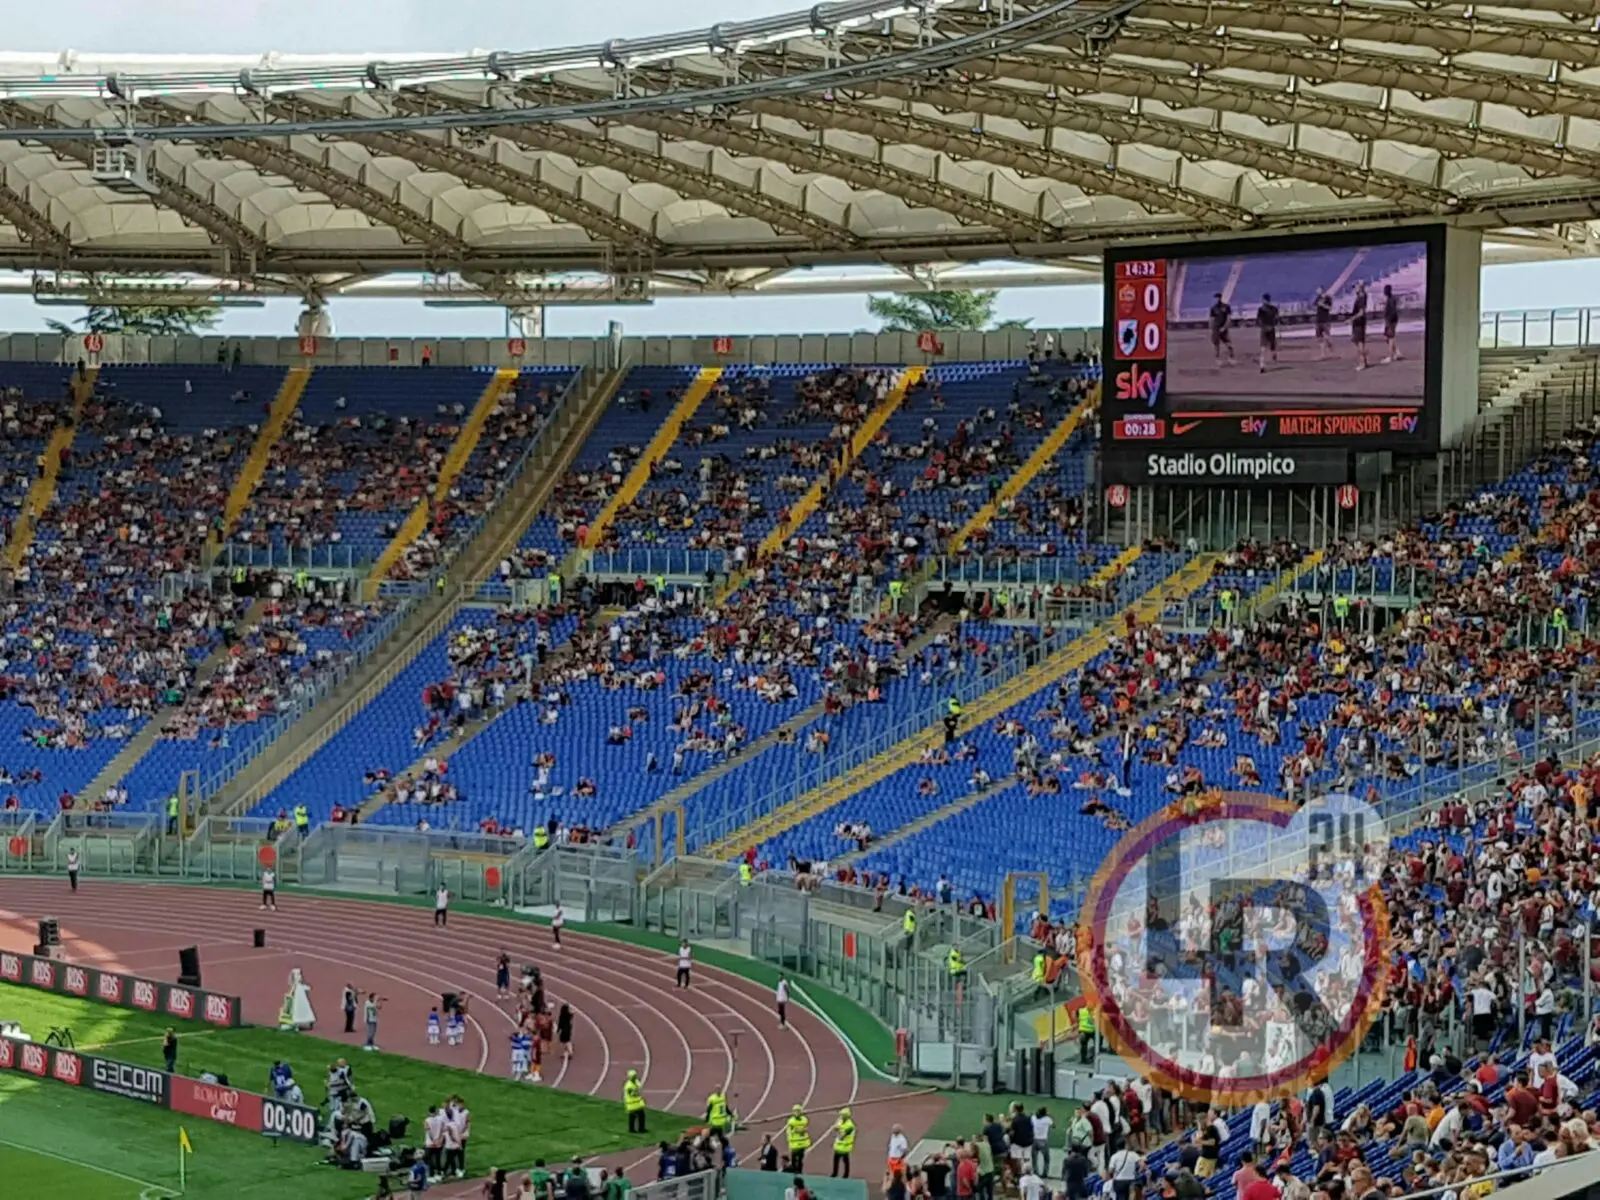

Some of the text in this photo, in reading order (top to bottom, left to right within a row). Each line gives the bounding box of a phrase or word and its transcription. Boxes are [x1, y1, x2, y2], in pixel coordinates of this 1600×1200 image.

[1125, 261, 1155, 276] 14:32
[1144, 284, 1160, 312] 0
[1144, 323, 1160, 351] 0
[1116, 362, 1163, 407] sky
[1125, 423, 1156, 436] 00:28
[1240, 413, 1418, 437] sky MATCH SPONSOR sky
[1148, 452, 1295, 480] Stadio Olimpico
[33, 960, 51, 983] RDS
[66, 966, 84, 989] RDS
[100, 973, 118, 997] RDS
[134, 980, 154, 1005] RDS
[170, 987, 190, 1012] RDS
[207, 995, 227, 1020] RDS
[22, 1044, 42, 1069] RDS
[55, 1051, 76, 1077] RDS
[263, 1102, 315, 1139] 00:00
